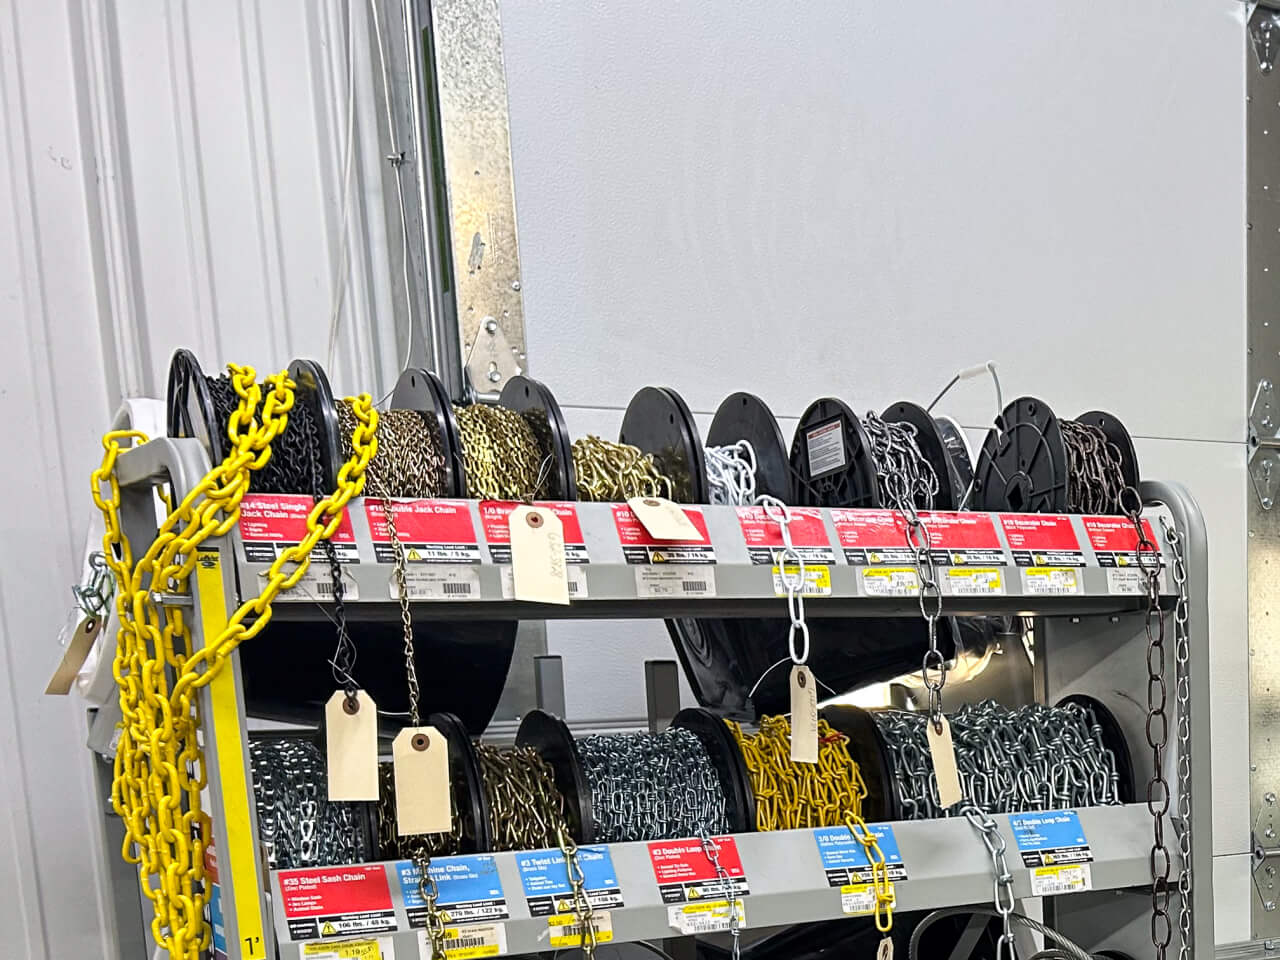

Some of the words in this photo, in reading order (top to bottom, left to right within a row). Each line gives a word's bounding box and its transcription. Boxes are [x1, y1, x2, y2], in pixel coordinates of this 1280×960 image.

[241, 510, 263, 518] Jack
[264, 510, 289, 518] Chain
[434, 506, 457, 514] Chain
[532, 857, 552, 865] Twist
[283, 877, 299, 887] #35
[301, 875, 322, 886] Steel
[323, 873, 342, 884] Sash
[342, 872, 366, 882] Chain
[435, 873, 452, 881] Link
